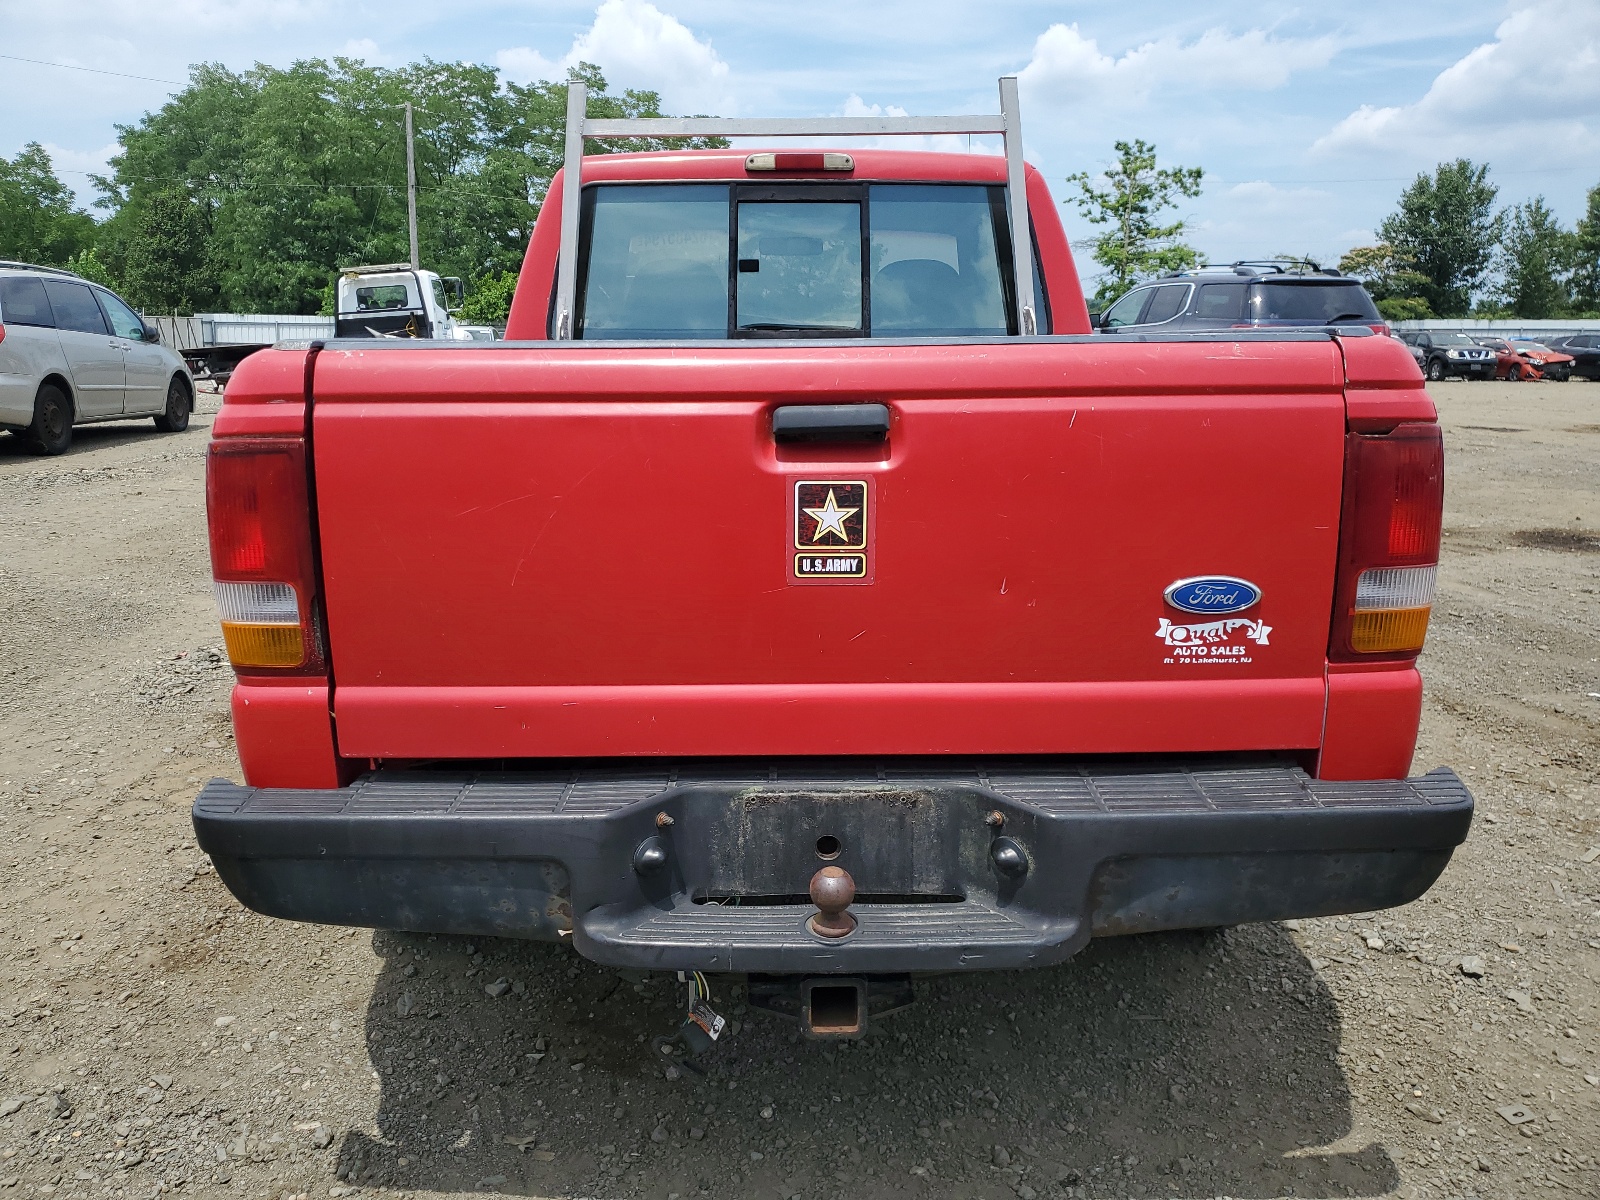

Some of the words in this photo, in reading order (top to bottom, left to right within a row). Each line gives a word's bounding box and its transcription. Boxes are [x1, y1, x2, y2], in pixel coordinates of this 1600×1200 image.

[1189, 585, 1240, 605] Ford
[1173, 646, 1208, 656] AUTO
[1210, 645, 1246, 655] SALES
